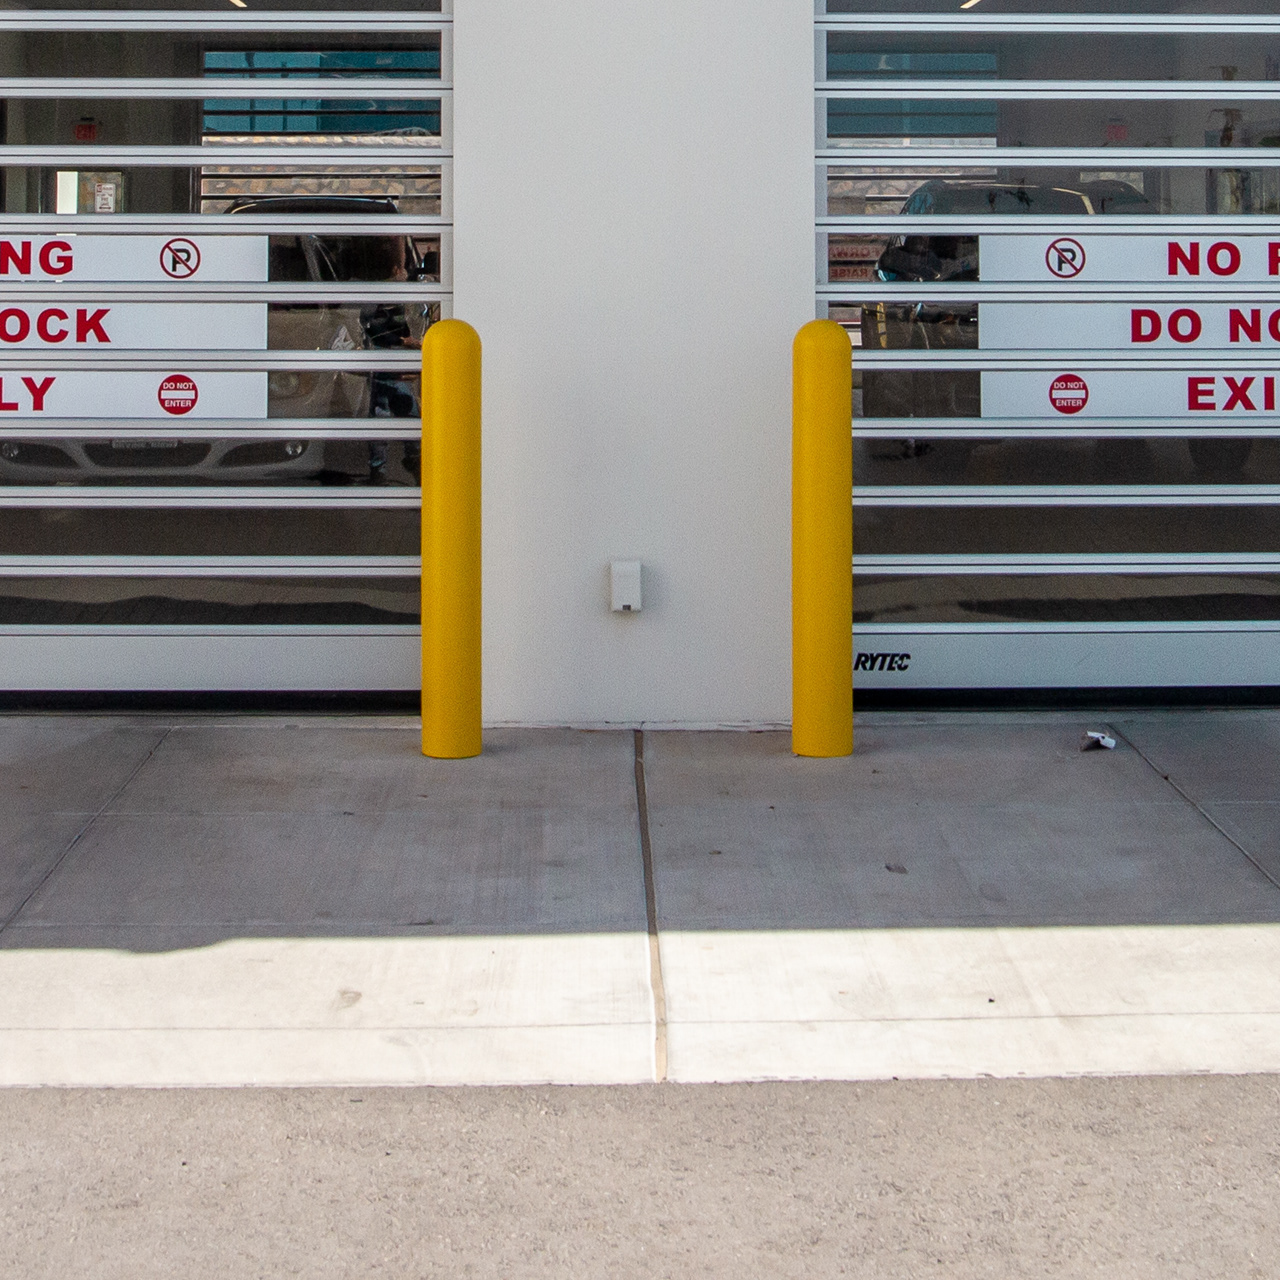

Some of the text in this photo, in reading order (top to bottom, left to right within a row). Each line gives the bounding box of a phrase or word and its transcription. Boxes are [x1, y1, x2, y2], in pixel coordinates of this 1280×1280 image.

[1168, 242, 1240, 275] NO
[1132, 309, 1201, 342] DO
[163, 382, 194, 390] DO NOT
[853, 653, 911, 671] RYTEC
